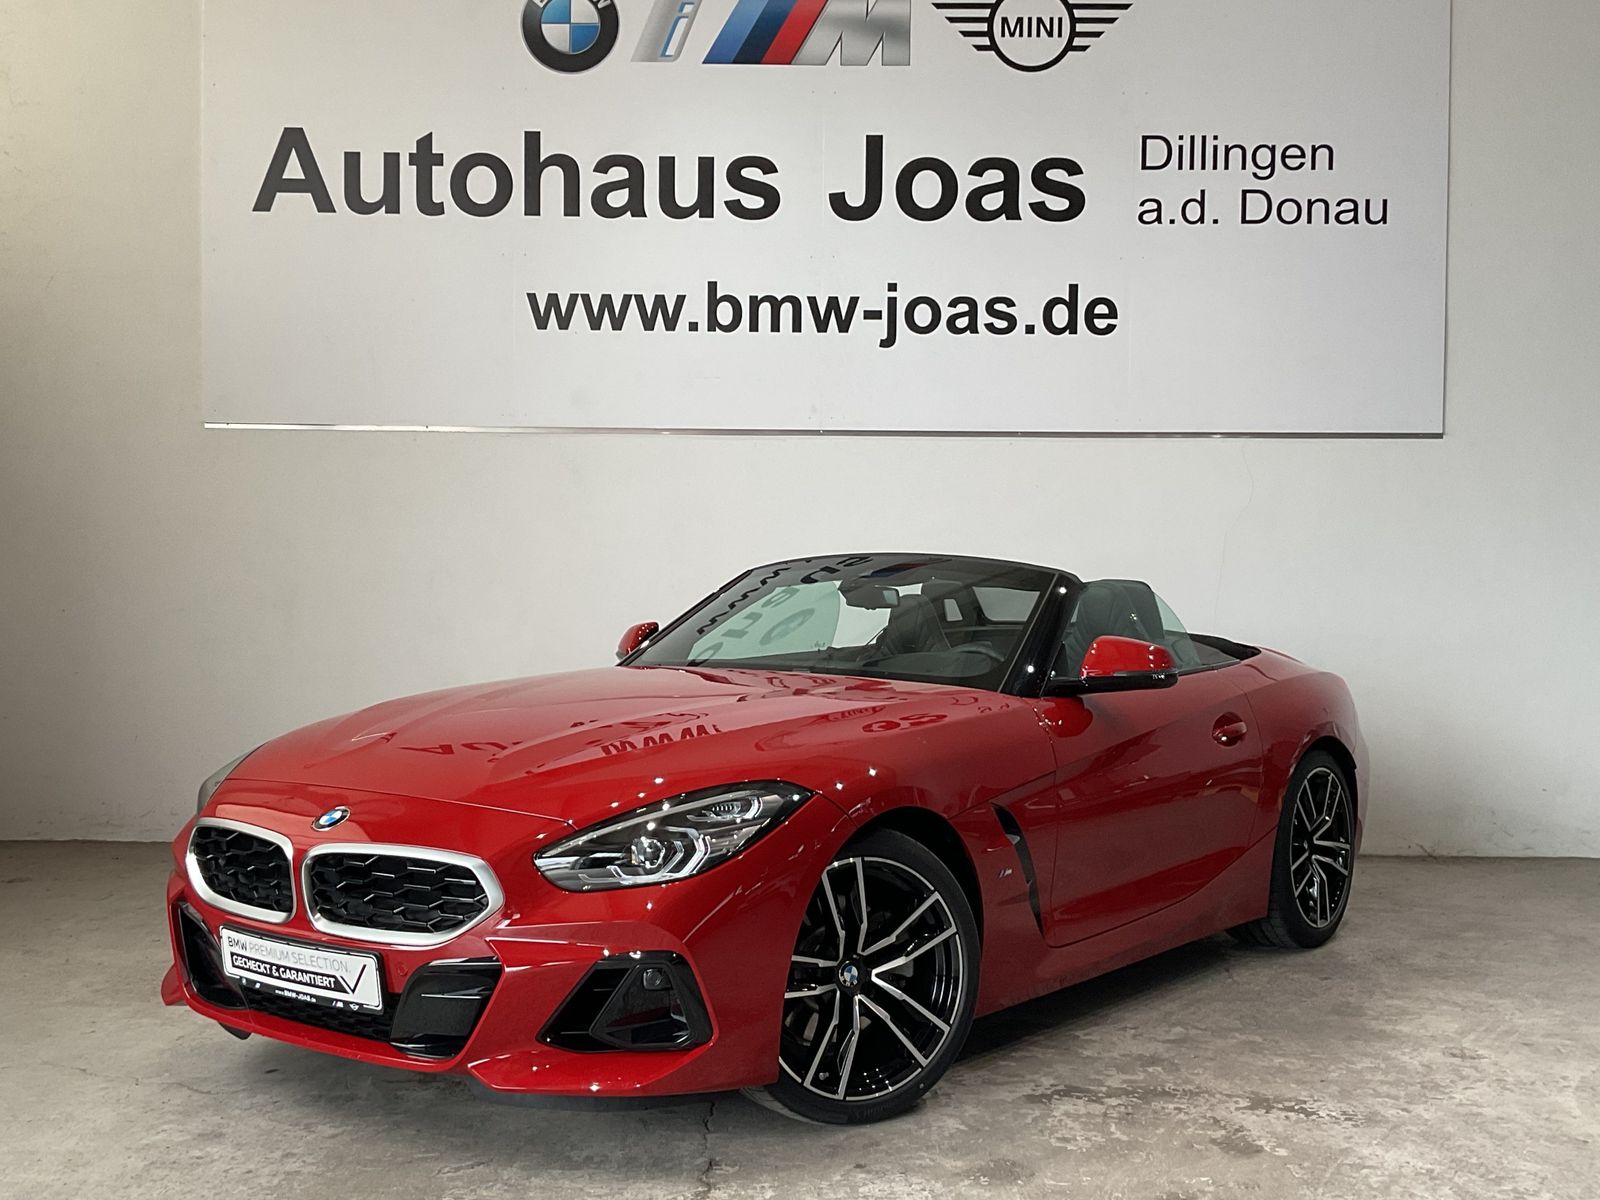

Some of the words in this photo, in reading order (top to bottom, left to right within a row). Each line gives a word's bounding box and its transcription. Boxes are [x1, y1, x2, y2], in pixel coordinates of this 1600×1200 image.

[1001, 16, 1063, 38] MINI
[253, 128, 781, 220] Autohaus
[829, 135, 1086, 223] Joas
[1141, 135, 1334, 181] Dillingen
[1138, 189, 1219, 225] a.d.
[1241, 190, 1388, 225] Donau
[527, 281, 1118, 348] www.bmw-joas.de
[227, 936, 248, 952] BMW
[248, 943, 291, 962] PREMIUM
[233, 955, 271, 975] GECHECKT
[271, 967, 280, 977] &
[279, 968, 336, 989] GARANTIERT
